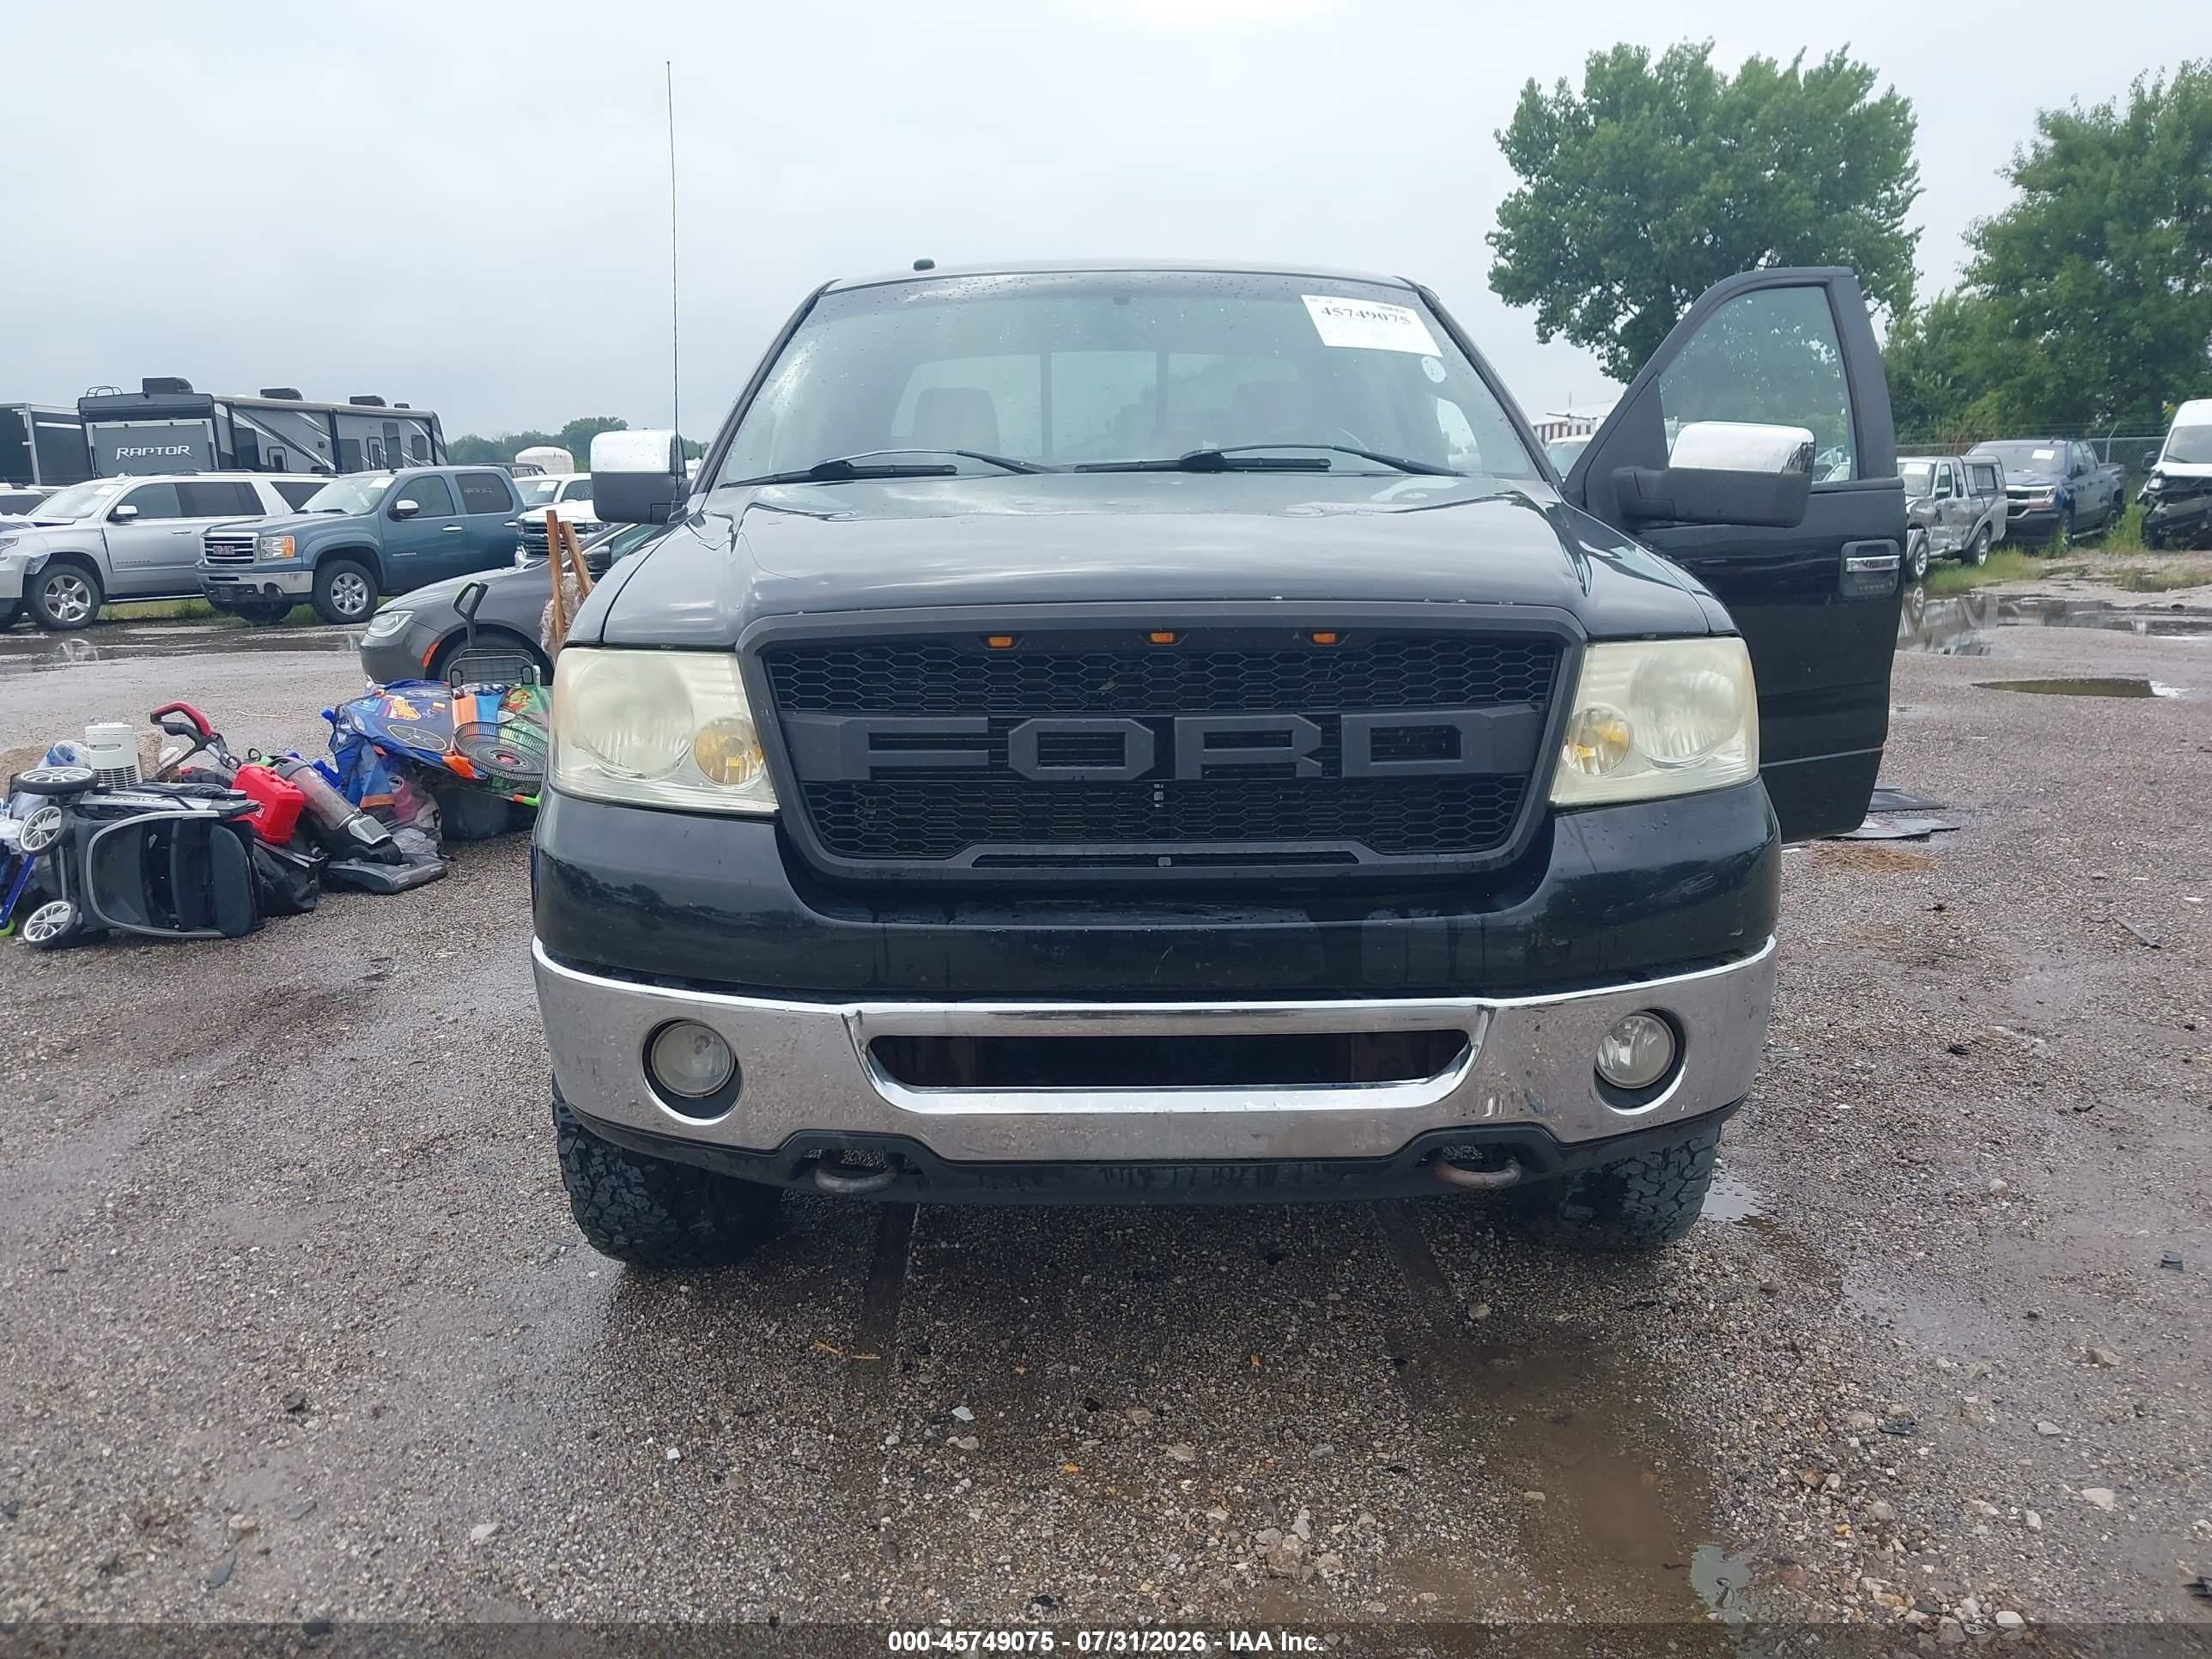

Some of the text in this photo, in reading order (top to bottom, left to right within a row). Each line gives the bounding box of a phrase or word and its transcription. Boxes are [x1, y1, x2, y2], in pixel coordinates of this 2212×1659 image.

[1322, 307, 1411, 325] 45749075
[116, 445, 194, 461] RAPTOR
[830, 711, 1501, 781] FORD
